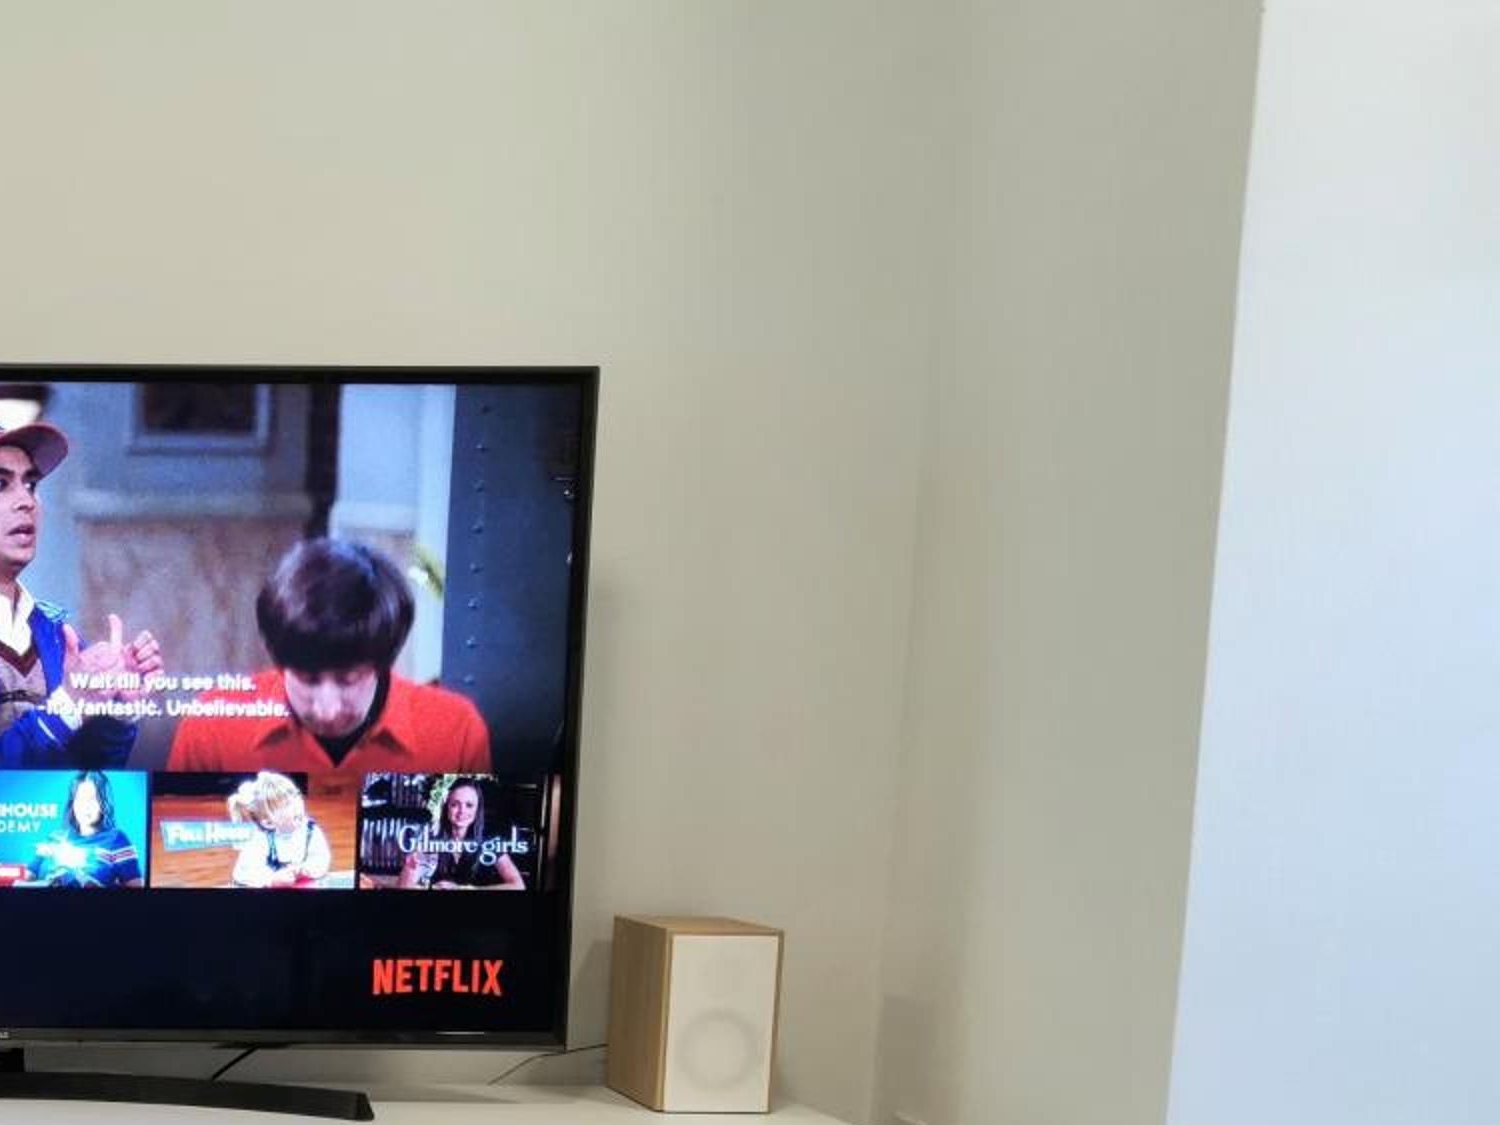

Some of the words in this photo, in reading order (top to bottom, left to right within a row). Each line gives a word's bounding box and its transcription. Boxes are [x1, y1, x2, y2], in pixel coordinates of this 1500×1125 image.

[69, 673, 109, 690] Wait
[144, 675, 178, 692] you
[182, 676, 214, 690] see
[217, 674, 257, 691] this.
[74, 699, 163, 718] fantastic.
[167, 700, 290, 718] Unbelievable.
[399, 825, 479, 854] Gilmore
[479, 825, 529, 866] girls
[372, 959, 503, 996] NETFLIX
